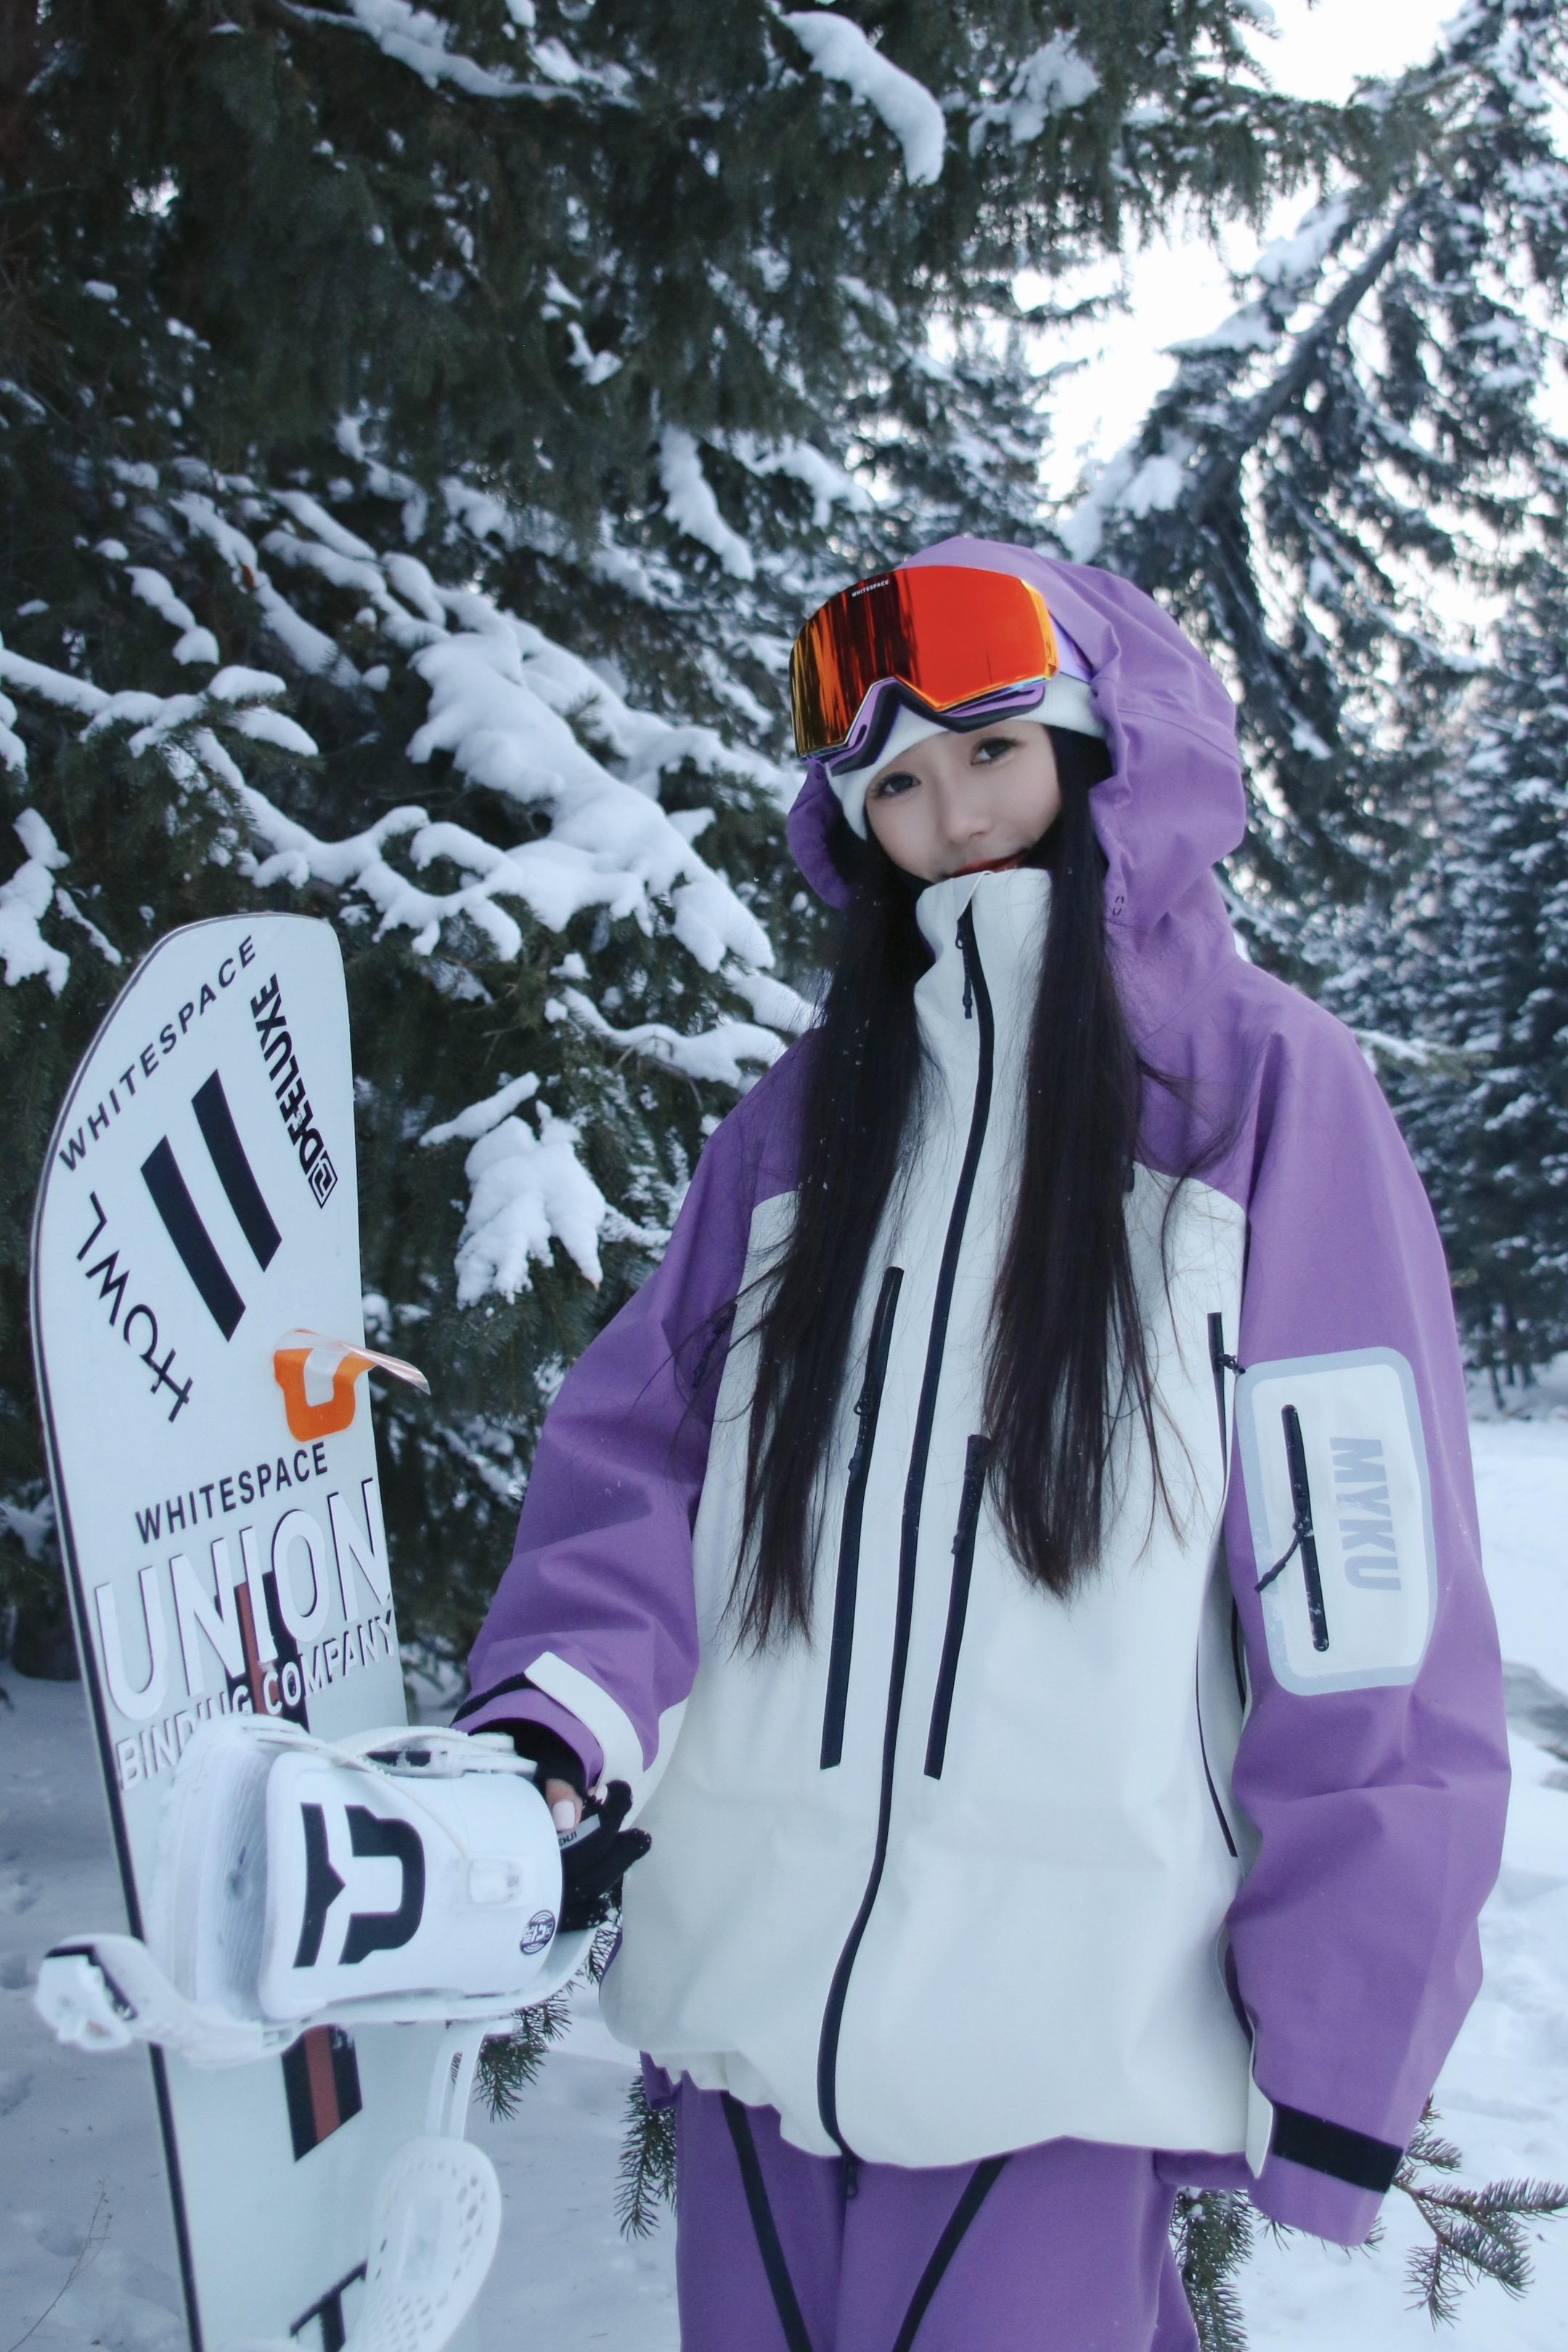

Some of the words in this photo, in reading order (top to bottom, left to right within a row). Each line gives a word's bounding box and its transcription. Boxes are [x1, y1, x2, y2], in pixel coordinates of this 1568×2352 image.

[852, 579, 889, 597] WHITESPACE
[60, 936, 256, 1172] WHITESPACE
[251, 973, 326, 1175] DEELUXE
[76, 1191, 193, 1423] HOWL
[135, 1442, 328, 1544] WHITESPACE
[1329, 1437, 1402, 1591] MYKU
[94, 1478, 393, 1721] UNION
[261, 1609, 395, 1716] COMPANY
